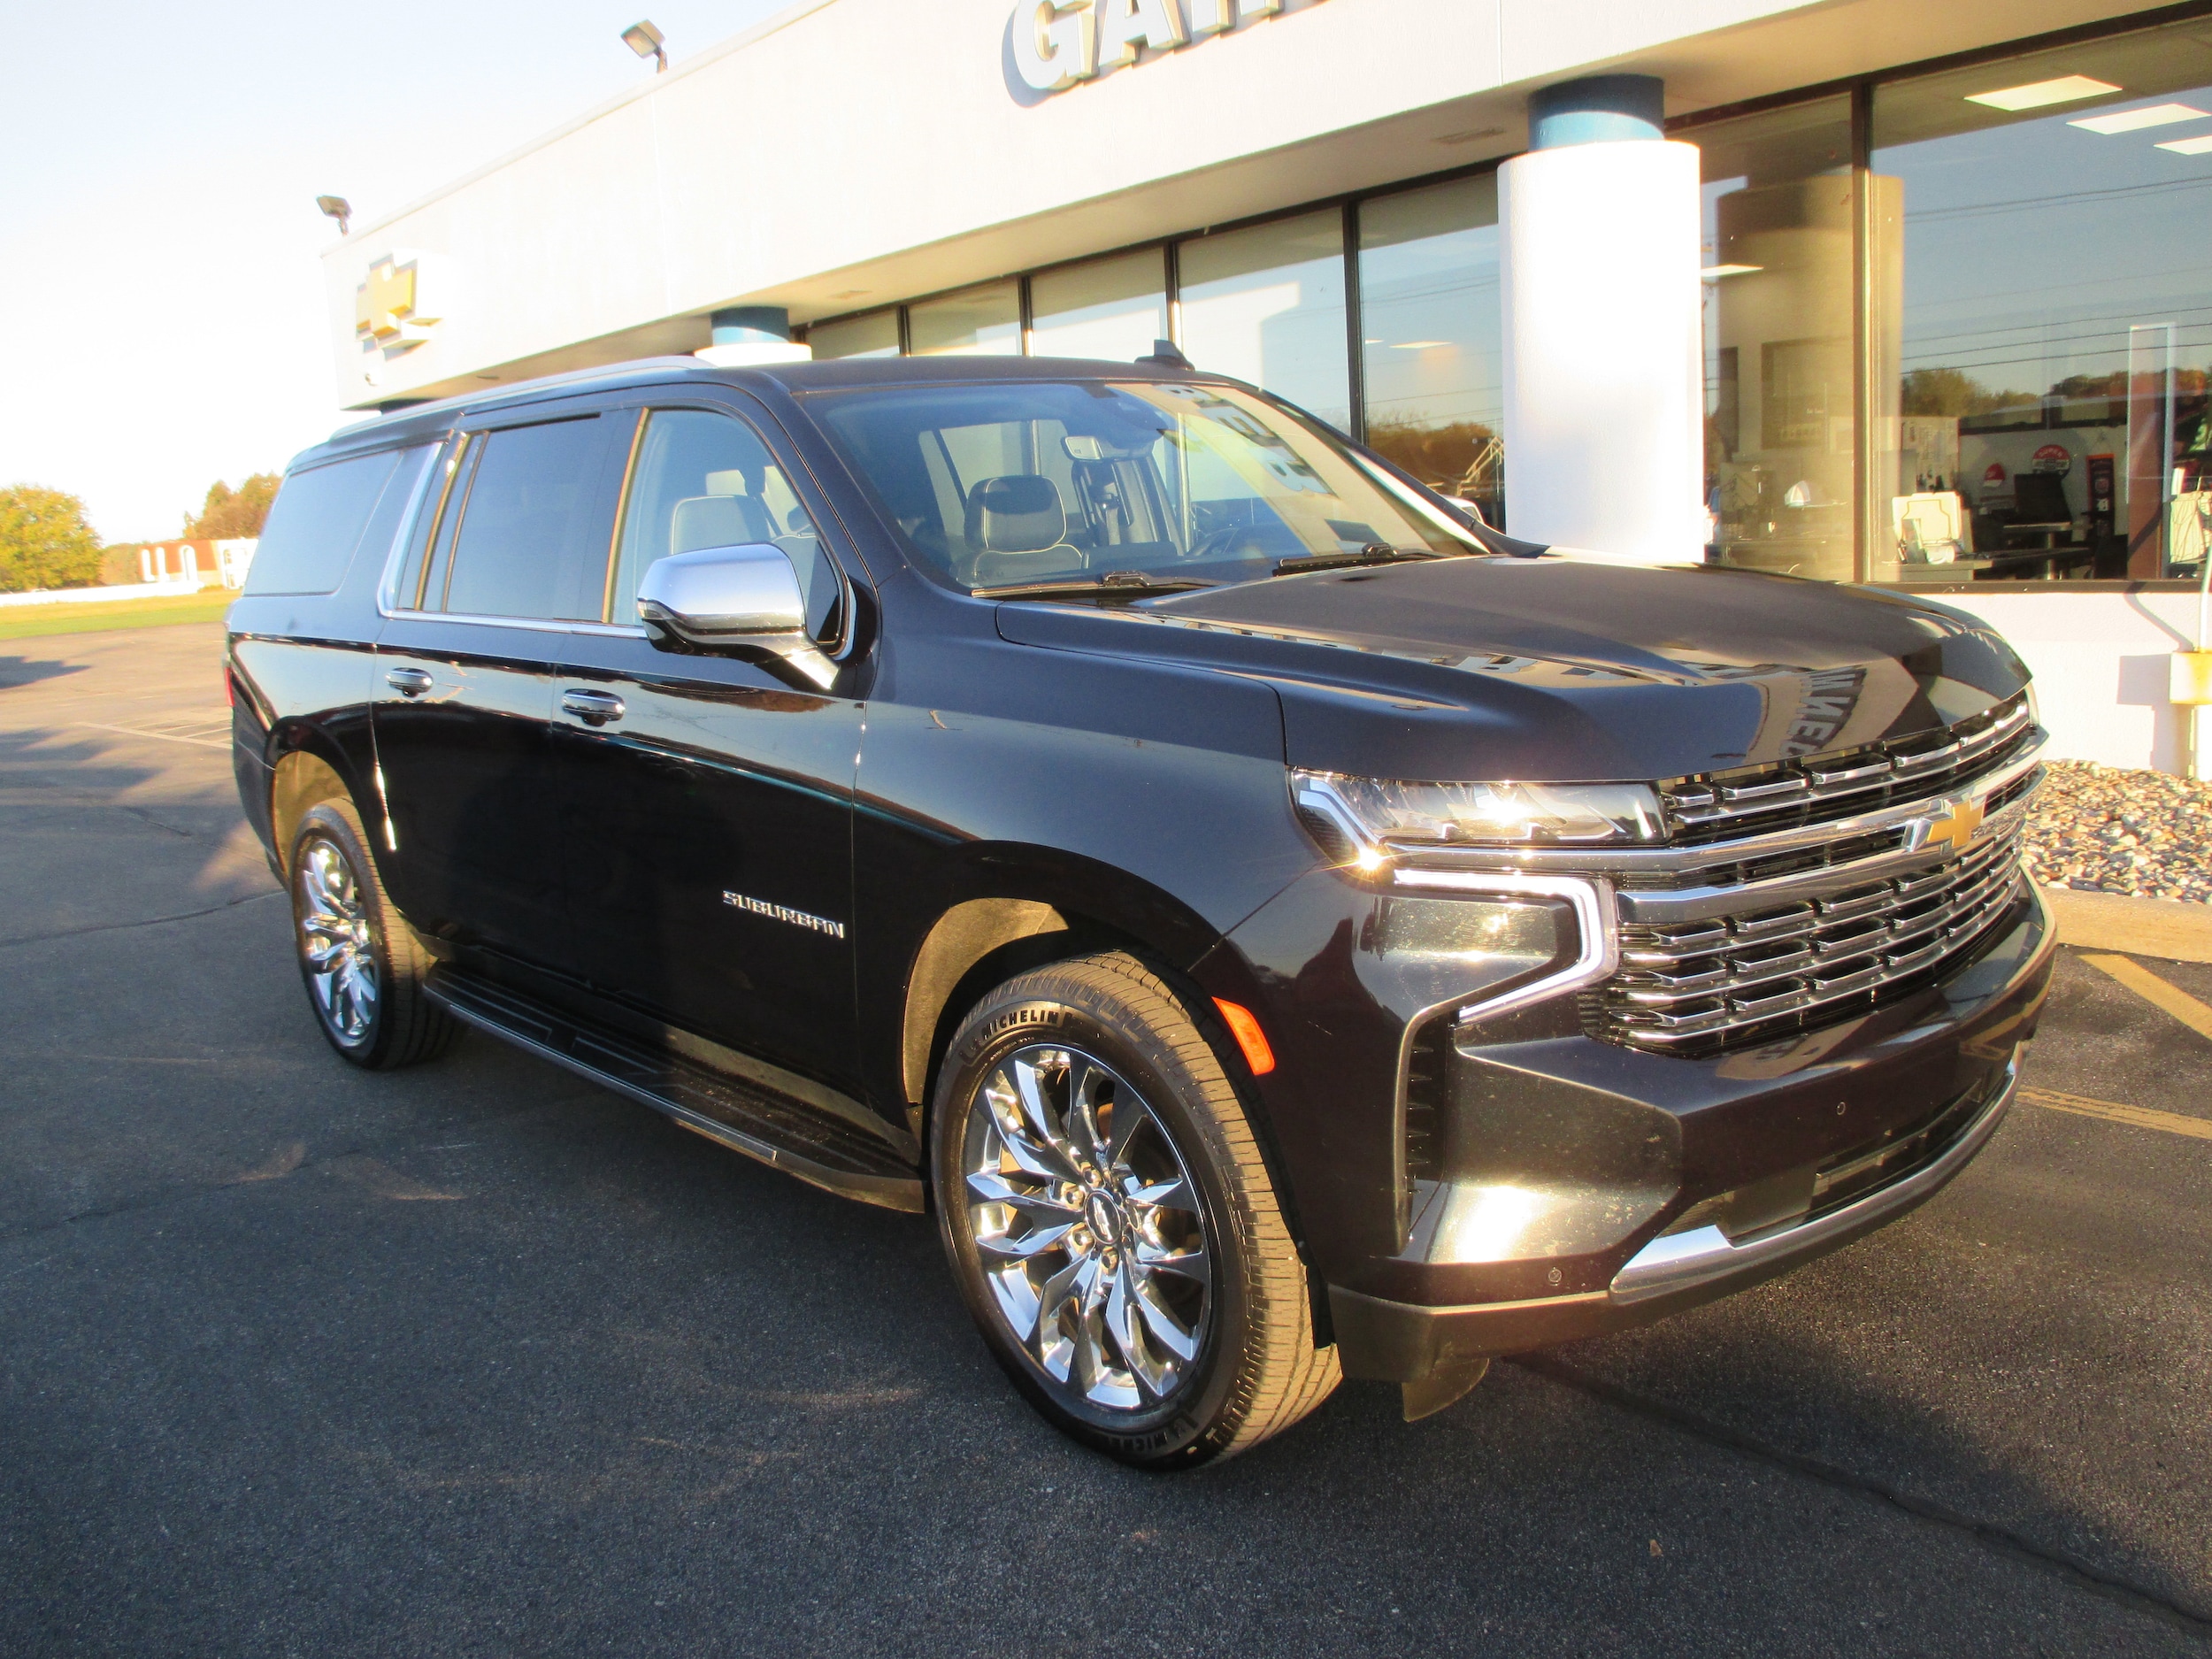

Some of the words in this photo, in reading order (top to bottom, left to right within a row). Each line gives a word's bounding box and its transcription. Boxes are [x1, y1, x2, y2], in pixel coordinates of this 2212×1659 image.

[1012, 0, 1284, 88] GA
[723, 890, 844, 939] SUBURBAN
[981, 1010, 1059, 1041] MICHELIN
